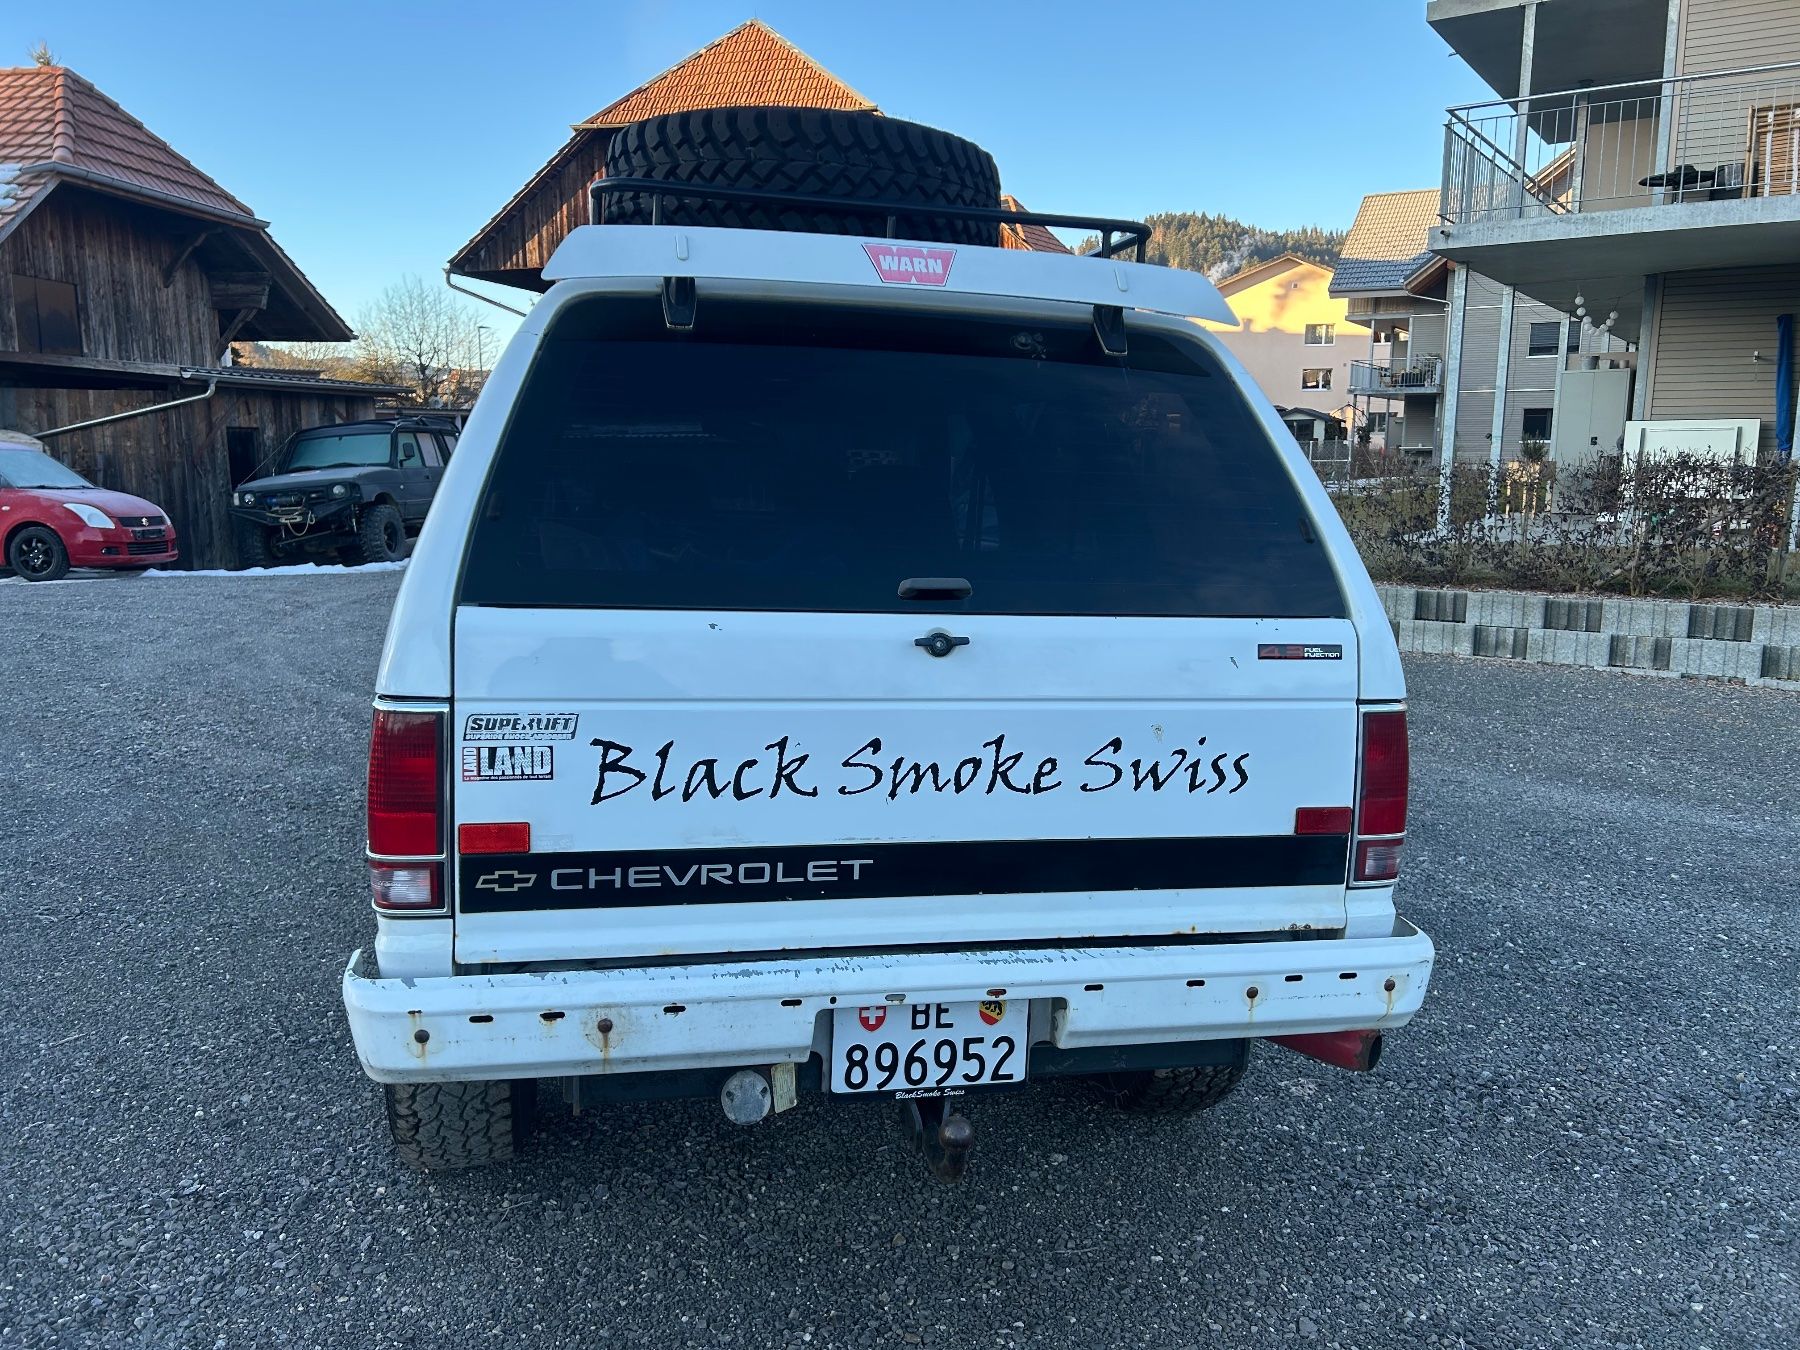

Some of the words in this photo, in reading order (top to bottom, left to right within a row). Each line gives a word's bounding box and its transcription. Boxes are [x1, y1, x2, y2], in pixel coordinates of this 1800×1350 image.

[879, 255, 943, 273] WARN
[479, 746, 552, 776] LAND
[589, 735, 818, 806] Black
[838, 733, 1062, 800] Smoke
[1079, 735, 1250, 795] Swiss
[550, 859, 874, 891] CHEVROLET
[844, 1036, 1015, 1090] 896952
[943, 1088, 965, 1096] Swiss
